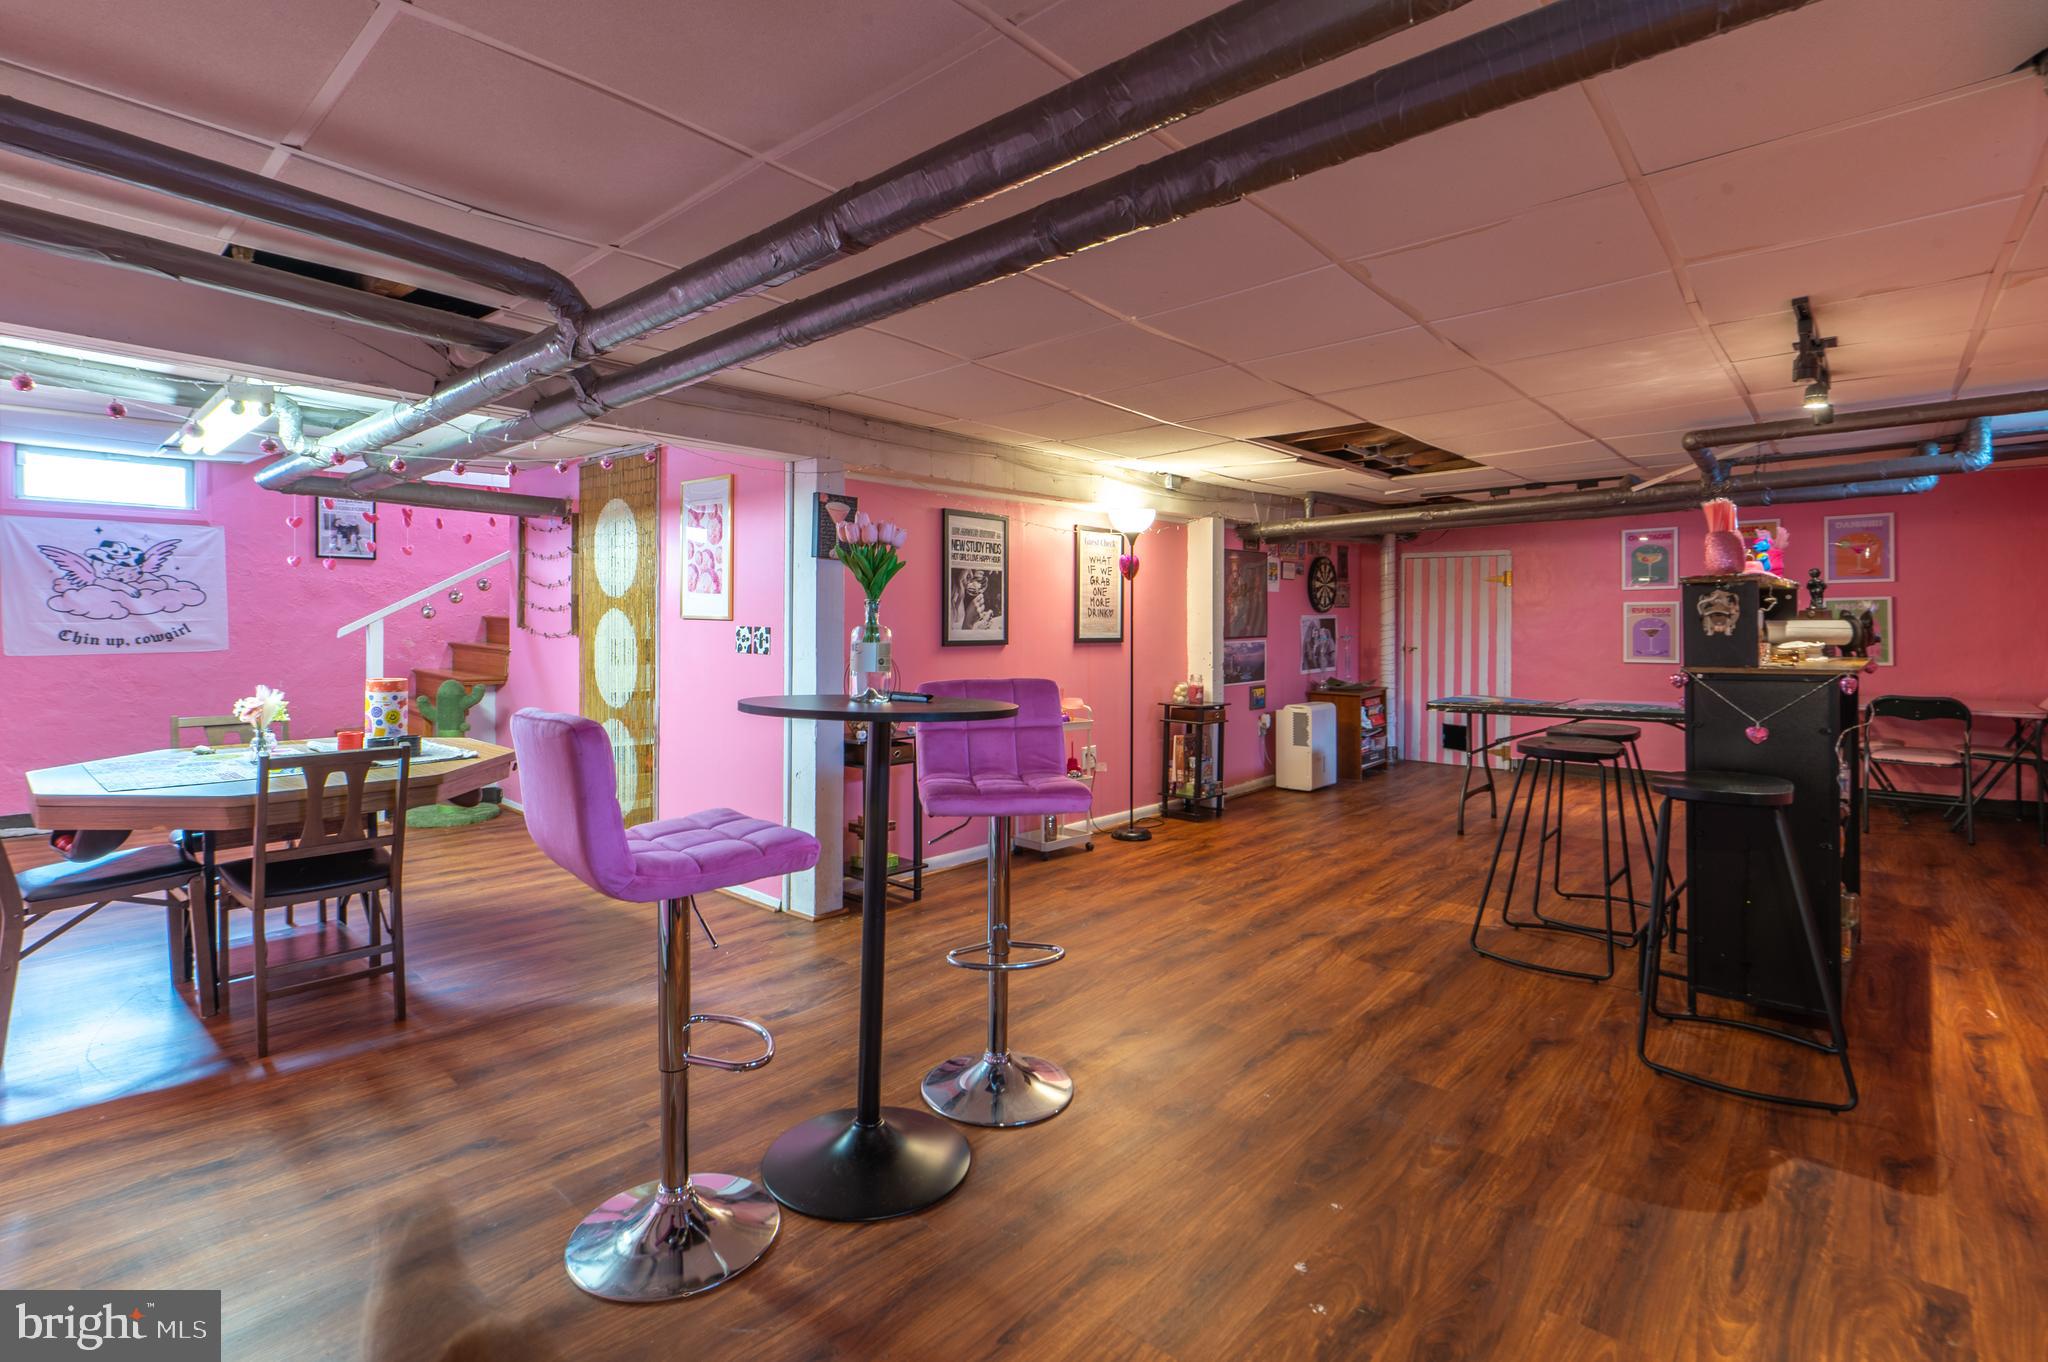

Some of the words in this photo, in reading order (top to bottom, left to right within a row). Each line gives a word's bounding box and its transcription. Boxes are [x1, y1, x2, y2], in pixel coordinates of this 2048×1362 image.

[952, 539, 966, 551] NEW
[966, 540, 985, 553] STUDY
[986, 542, 1001, 554] FINDS
[1089, 556, 1112, 565] WHAT
[1088, 565, 1096, 574] IF
[1100, 567, 1112, 576] WE
[1090, 576, 1110, 586] GRAB
[1093, 587, 1107, 596] ONE
[1090, 597, 1110, 608] MORE
[58, 629, 100, 645] Chin
[135, 623, 192, 643] cowgirl
